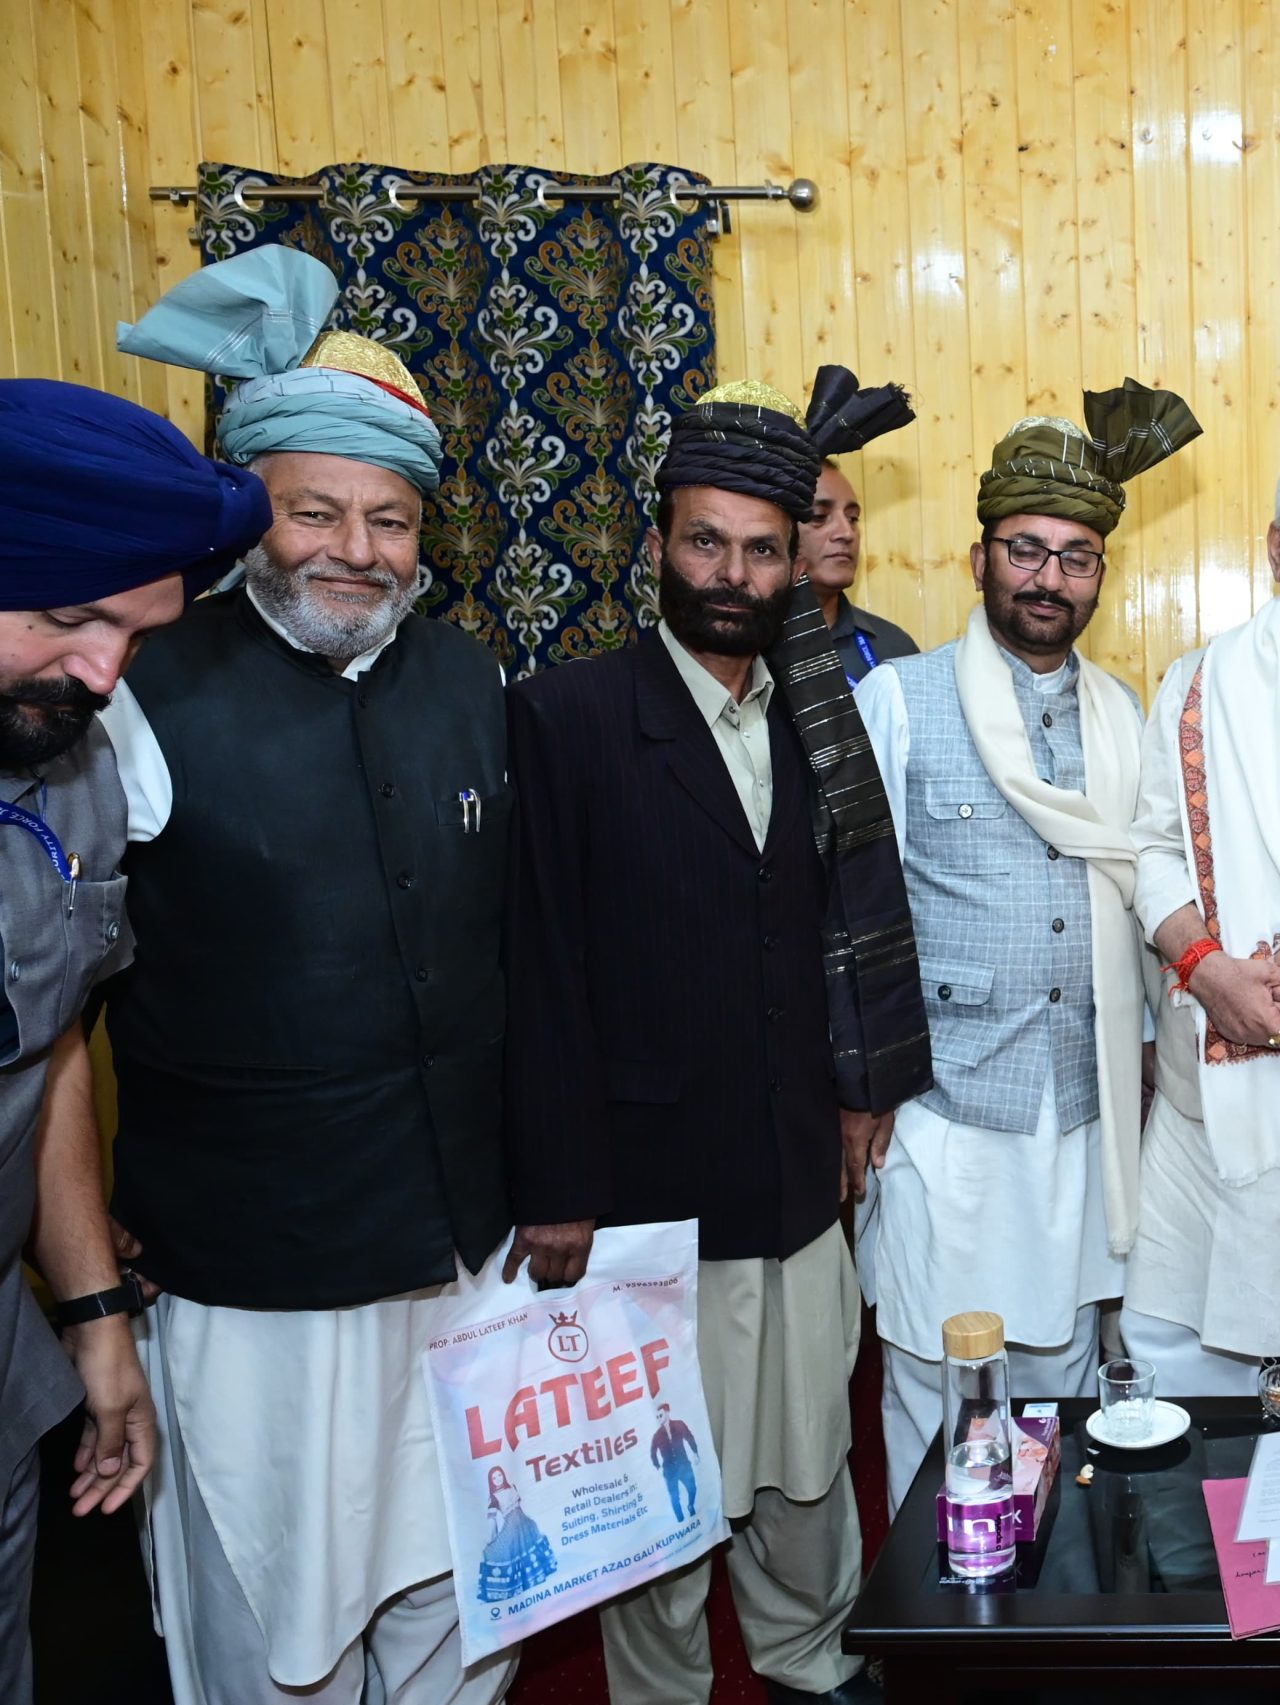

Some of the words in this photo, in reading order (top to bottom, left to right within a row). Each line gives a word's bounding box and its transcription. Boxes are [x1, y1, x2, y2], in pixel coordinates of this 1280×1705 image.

[453, 1331, 477, 1345] ABDUL
[479, 1321, 506, 1337] LATEEF
[508, 1312, 528, 1327] KHAN
[557, 1334, 580, 1351] LT
[465, 1338, 670, 1460] LATEEF
[525, 1428, 638, 1482] Textiles
[564, 1499, 591, 1516] Retail
[593, 1489, 629, 1506] Dealers
[572, 1478, 622, 1498] Wholesale
[623, 1474, 629, 1483] &
[561, 1513, 599, 1531] Suiting,
[601, 1499, 637, 1517] Shirting
[637, 1493, 643, 1502] &
[561, 1529, 589, 1546] Dress
[591, 1514, 636, 1534] Materials
[508, 1589, 551, 1615] MADINA
[553, 1569, 599, 1594] MARKET
[601, 1558, 632, 1575] AZAD
[656, 1519, 701, 1551] KUPWARA
